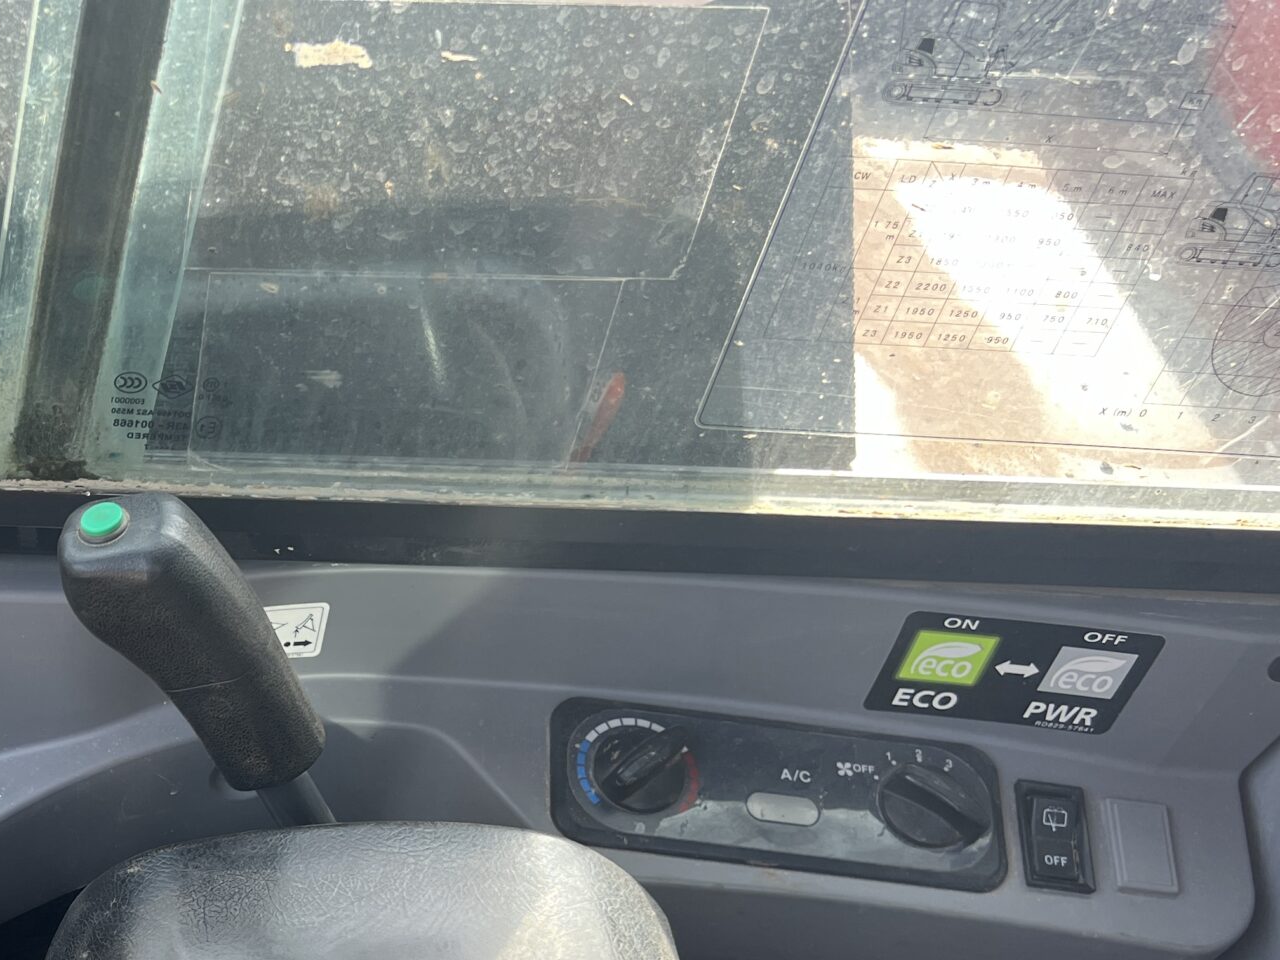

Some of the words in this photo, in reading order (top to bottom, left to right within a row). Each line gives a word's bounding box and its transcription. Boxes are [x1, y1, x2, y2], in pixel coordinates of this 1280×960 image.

[854, 172, 872, 181] CW
[900, 174, 917, 184] LD
[1150, 188, 1177, 200] MAX
[896, 256, 912, 265] Z3
[884, 280, 901, 290] Z2
[915, 282, 948, 292] 2200
[1054, 290, 1080, 300] 800
[874, 305, 888, 313] Z1
[905, 306, 936, 317] 1950
[948, 309, 980, 320] 1250
[862, 330, 878, 338] Z3
[894, 330, 923, 340] 1950
[938, 332, 966, 343] 1250
[1210, 414, 1221, 424] 2
[944, 618, 980, 630] ON
[1083, 632, 1128, 646] OFF
[918, 658, 972, 678] eco
[1058, 670, 1113, 692] eco
[892, 688, 958, 710] ECO
[1022, 701, 1098, 726] PWR
[780, 768, 811, 784] A/C
[853, 764, 874, 774] OFF
[1044, 854, 1068, 867] OFF
